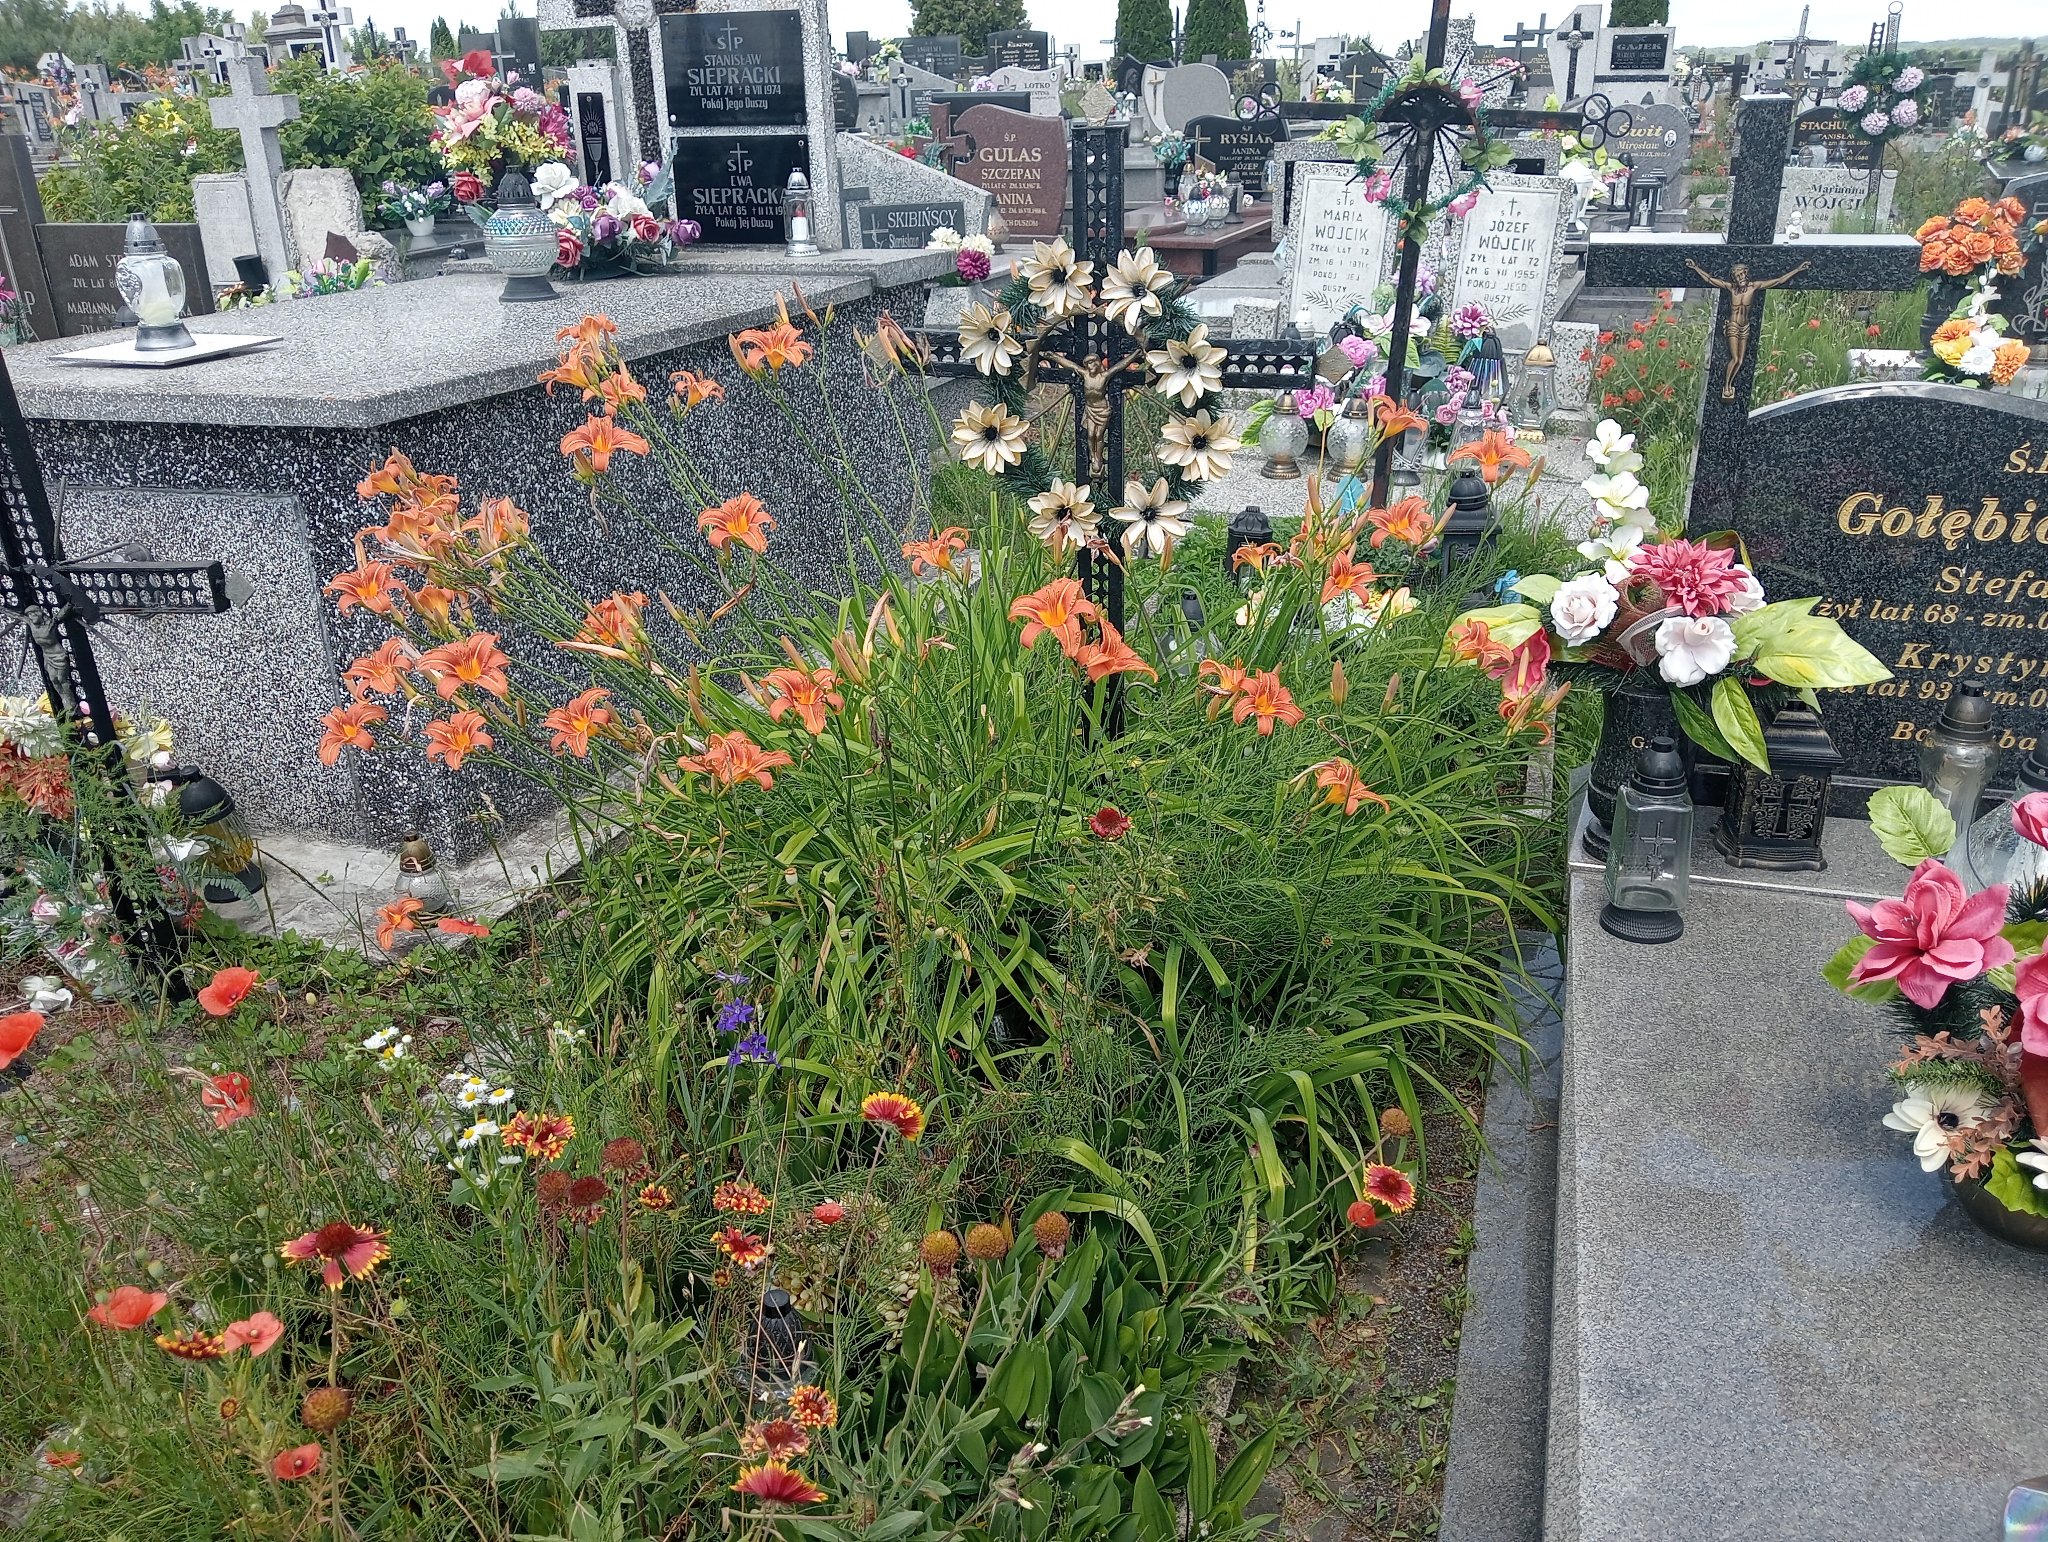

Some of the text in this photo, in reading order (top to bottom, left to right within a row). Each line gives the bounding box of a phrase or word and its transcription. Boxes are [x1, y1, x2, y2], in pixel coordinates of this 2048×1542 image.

[704, 53, 762, 67] STANISŁAW
[687, 66, 781, 86] SIEPRACKI
[706, 85, 722, 96] LAT
[723, 85, 734, 96] 74
[764, 84, 782, 95] 1974
[701, 97, 768, 111] Pokój Jego Duszy
[979, 147, 1043, 163] GULAS
[1231, 147, 1261, 155] JANINA
[981, 168, 1042, 180] SZCZEPAN
[995, 193, 1034, 205] ANINA
[718, 205, 733, 216] LAT
[735, 205, 748, 216] 85
[1323, 209, 1363, 222] MARIA
[750, 216, 774, 229] Duszy
[887, 207, 958, 229] SKIBIŃSCY
[1479, 234, 1537, 252] WÓJCIK
[1361, 247, 1370, 256] 72
[69, 253, 99, 268] ADAM
[1528, 257, 1540, 267] 72
[1465, 266, 1478, 275] ZM
[91, 277, 106, 289] LAT
[67, 301, 118, 316] MARIANNA
[1817, 597, 1862, 620] żył
[1869, 599, 1914, 622] lat
[1923, 603, 1960, 624] 68
[1918, 680, 1954, 701] 93
